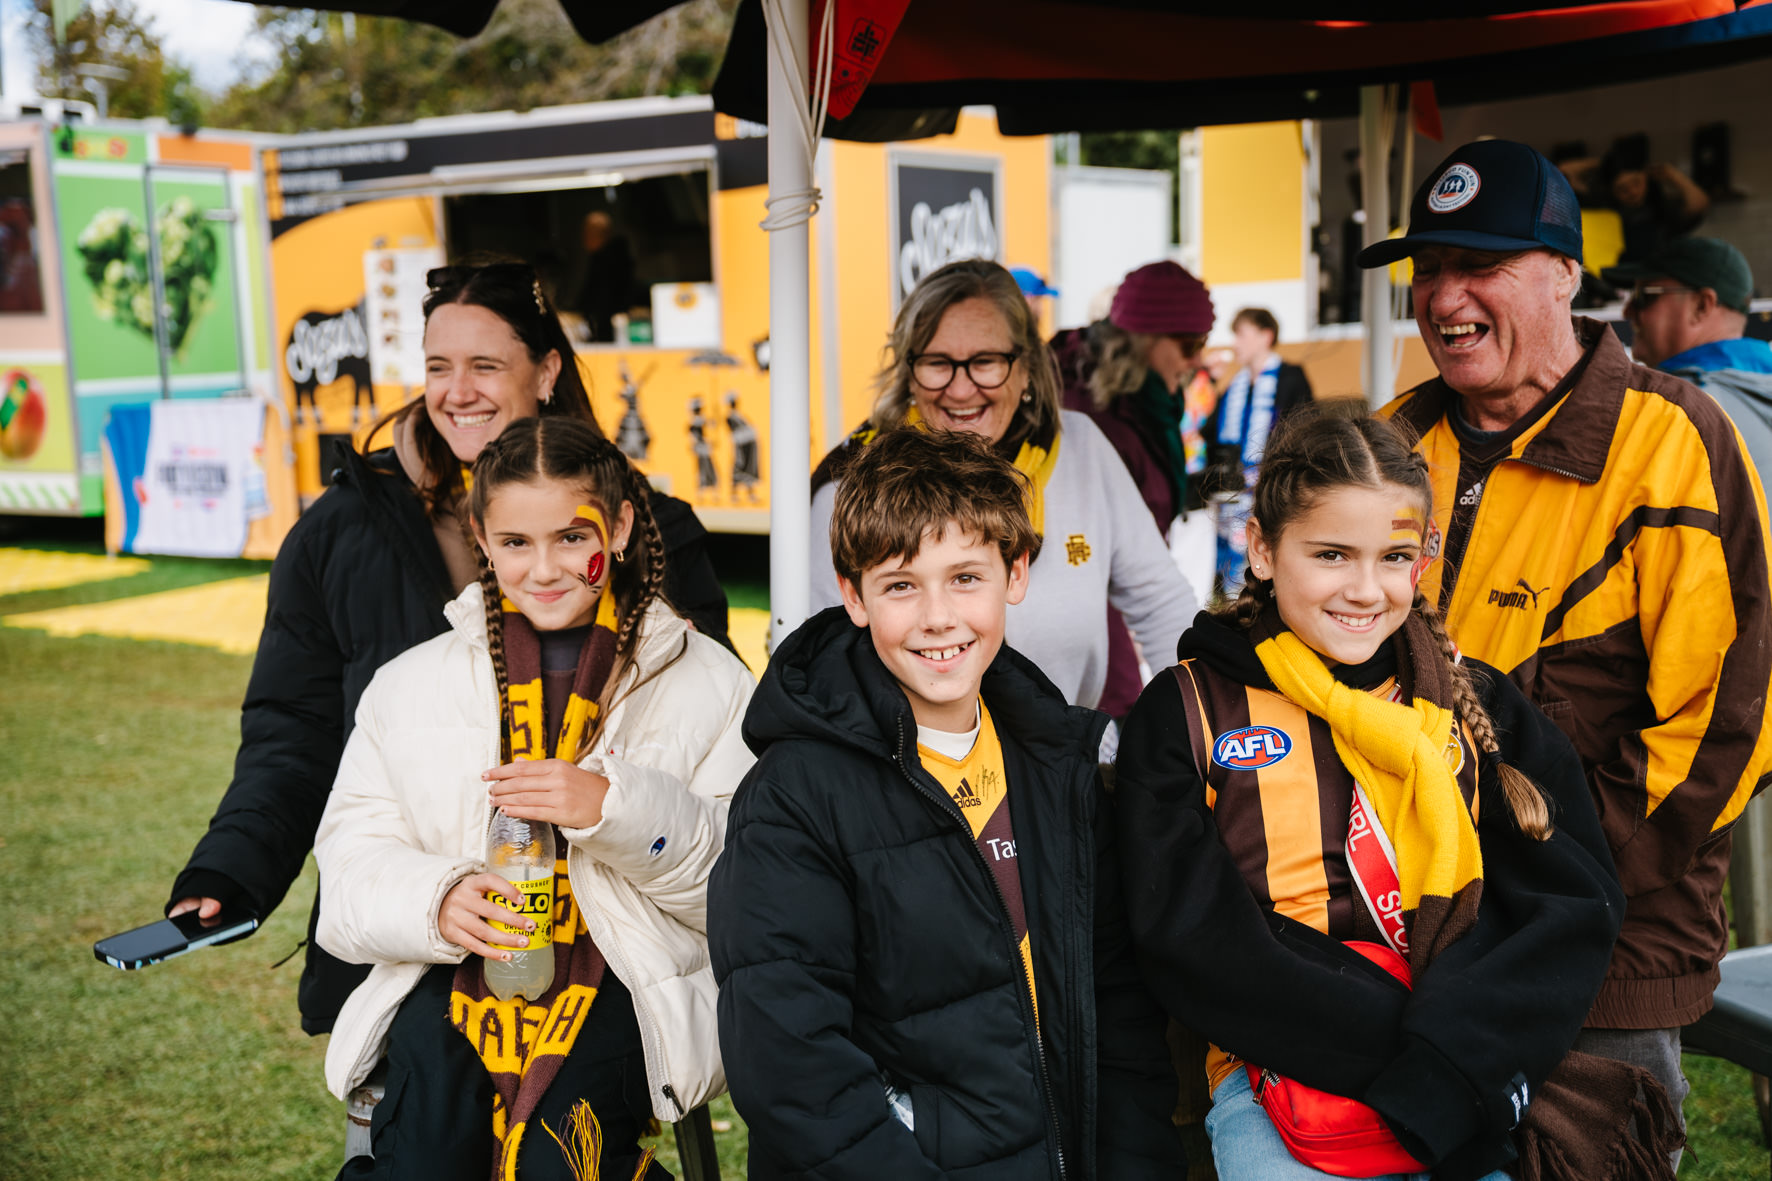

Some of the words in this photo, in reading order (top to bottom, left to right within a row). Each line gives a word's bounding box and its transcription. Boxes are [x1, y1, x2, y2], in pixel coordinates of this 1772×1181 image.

[1488, 589, 1528, 610] PUMA
[1221, 734, 1286, 762] AFL
[956, 797, 981, 809] didas
[495, 894, 548, 912] SOLO
